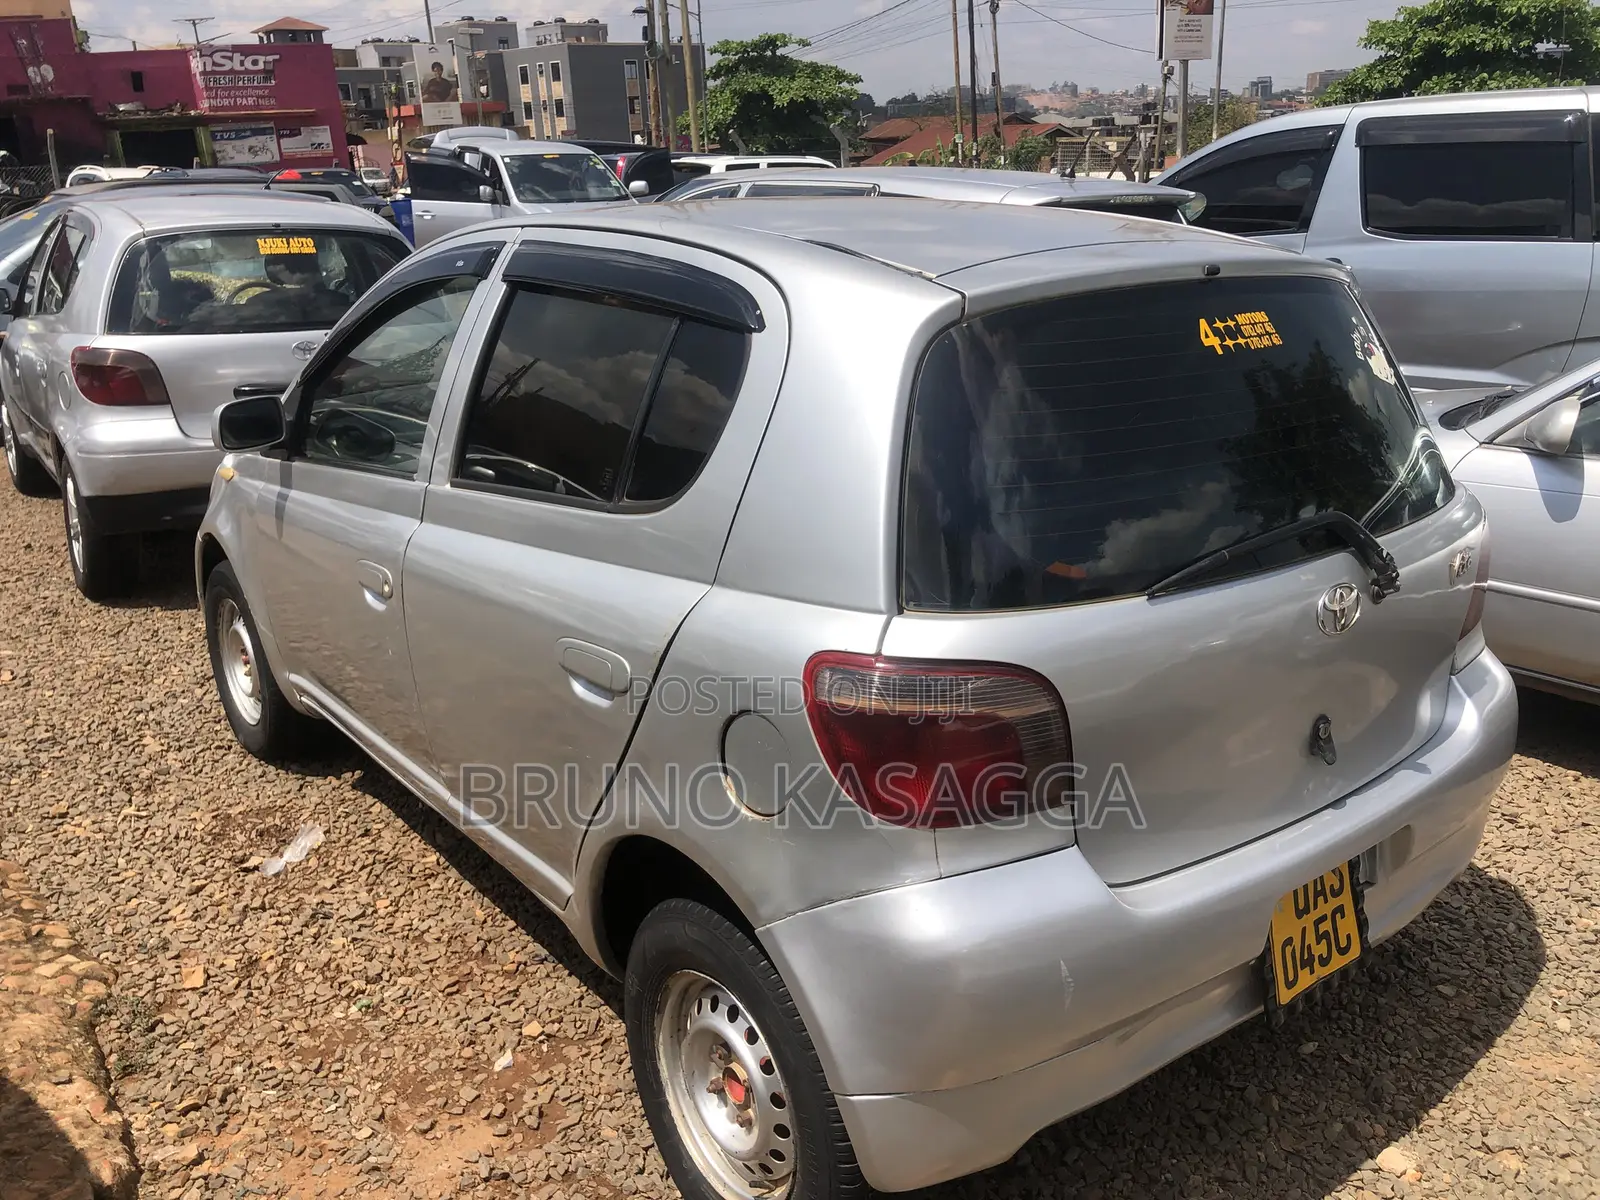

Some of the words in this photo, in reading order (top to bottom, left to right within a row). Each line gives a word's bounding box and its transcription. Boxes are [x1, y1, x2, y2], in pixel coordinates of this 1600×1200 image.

[190, 50, 280, 71] nStar
[207, 75, 233, 86] FRESH
[236, 74, 274, 85] PERFUME
[217, 88, 228, 98] for
[230, 87, 269, 97] excellence
[236, 96, 276, 106] PARTNER
[214, 131, 236, 140] TVS
[289, 237, 314, 248] AUTO
[1234, 311, 1269, 325] MOTORS
[1199, 318, 1223, 355] 4
[1280, 904, 1352, 991] 045C
